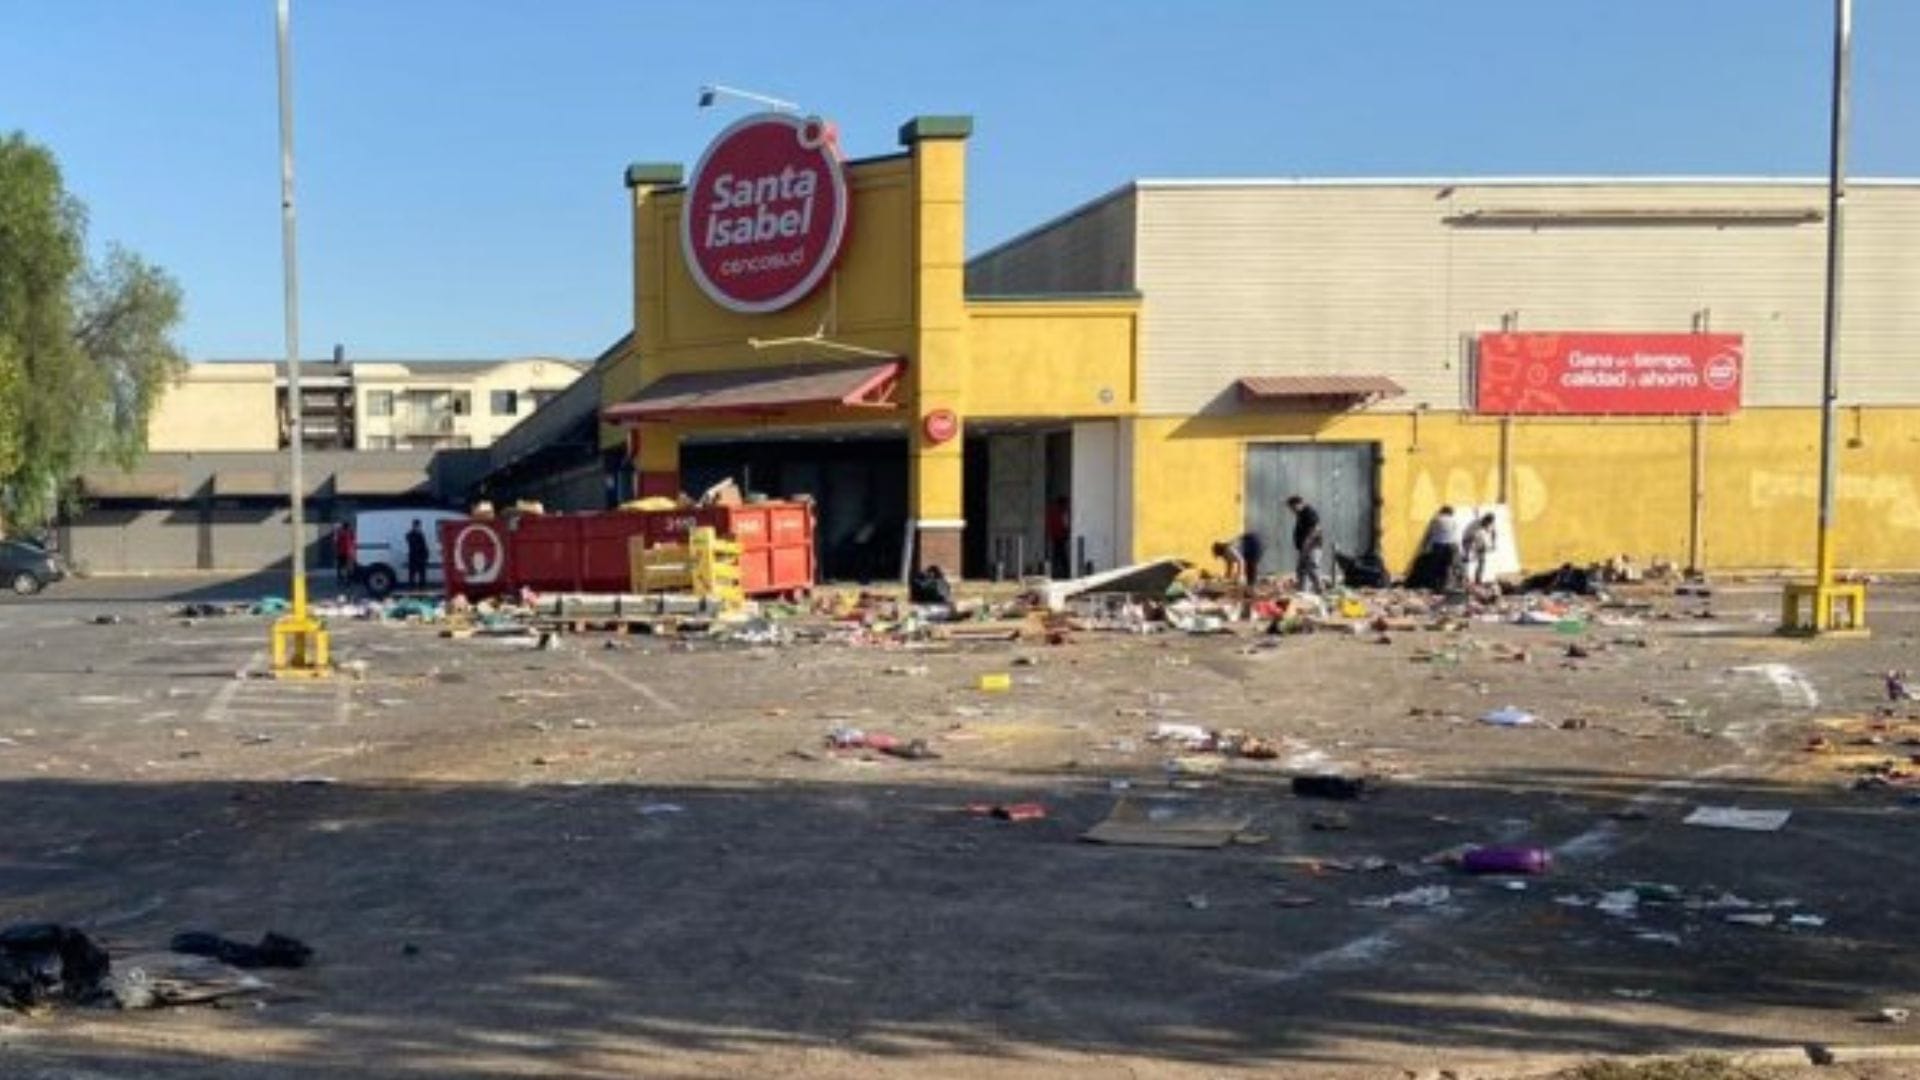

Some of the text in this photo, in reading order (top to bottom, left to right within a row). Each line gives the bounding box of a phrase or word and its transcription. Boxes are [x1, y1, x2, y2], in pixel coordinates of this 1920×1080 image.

[711, 165, 817, 211] Santa
[705, 198, 814, 248] Isabel
[1569, 350, 1613, 368] Gana
[1560, 369, 1627, 387] calidad
[1638, 370, 1699, 388] ahorro
